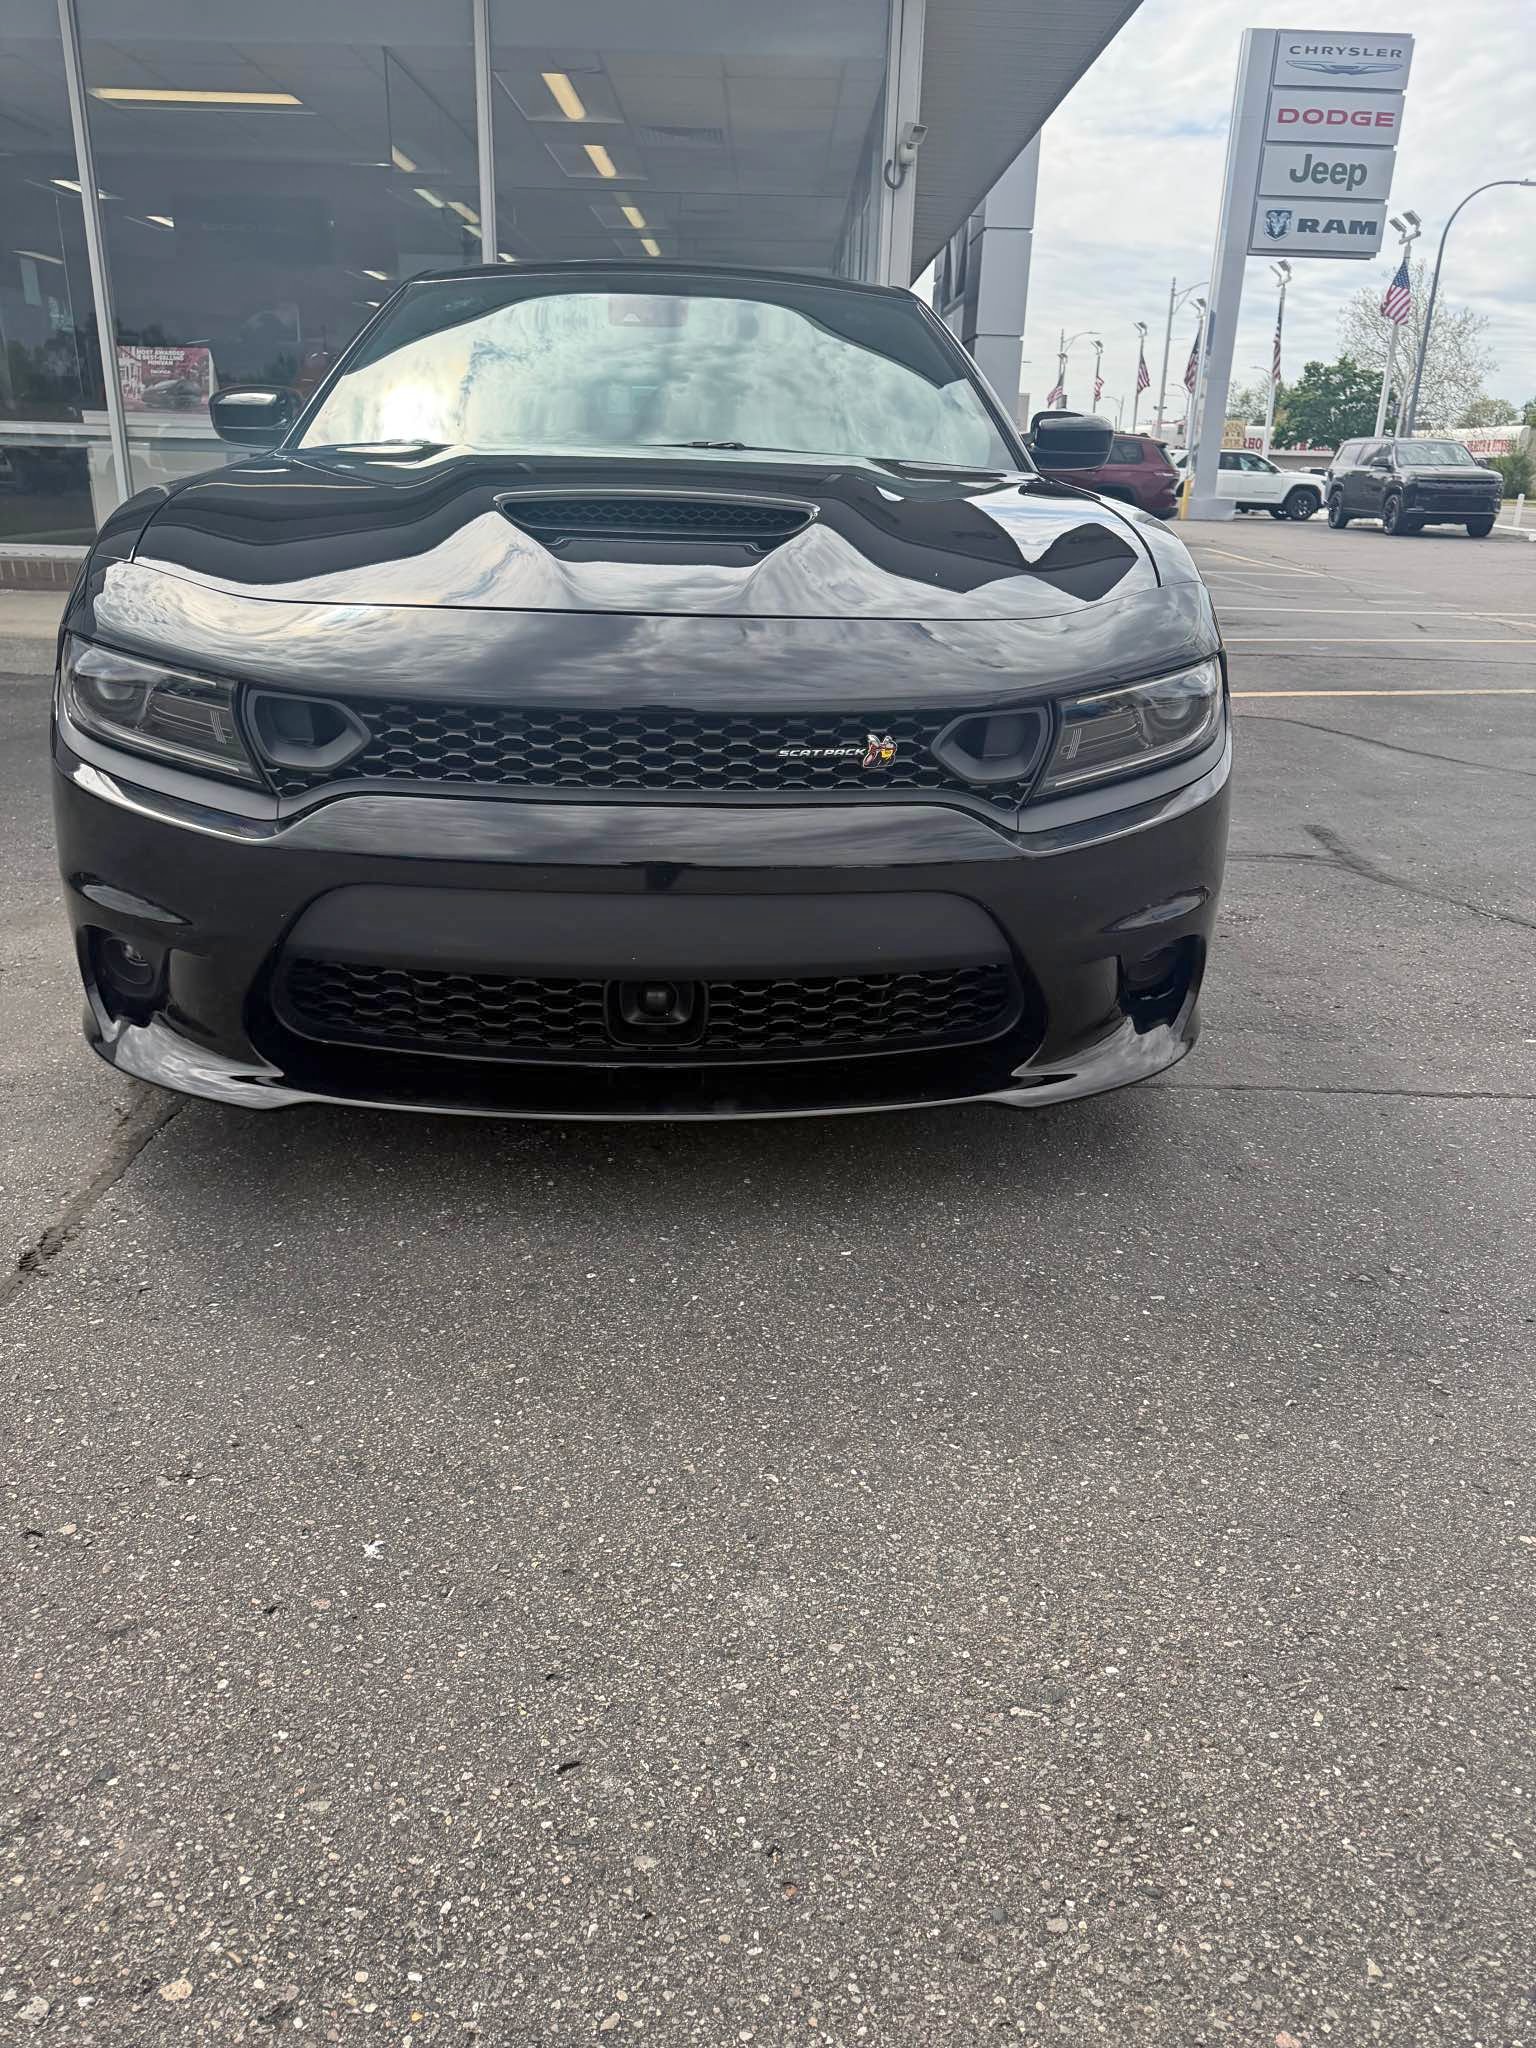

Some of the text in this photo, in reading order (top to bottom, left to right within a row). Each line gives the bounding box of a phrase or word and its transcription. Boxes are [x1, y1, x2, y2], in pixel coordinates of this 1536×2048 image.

[1288, 44, 1403, 58] CHRYSLER
[1277, 107, 1395, 128] DODGE
[1289, 153, 1368, 192] Jeep
[1297, 217, 1378, 236] RAM
[778, 748, 866, 757] SCAT PACK
